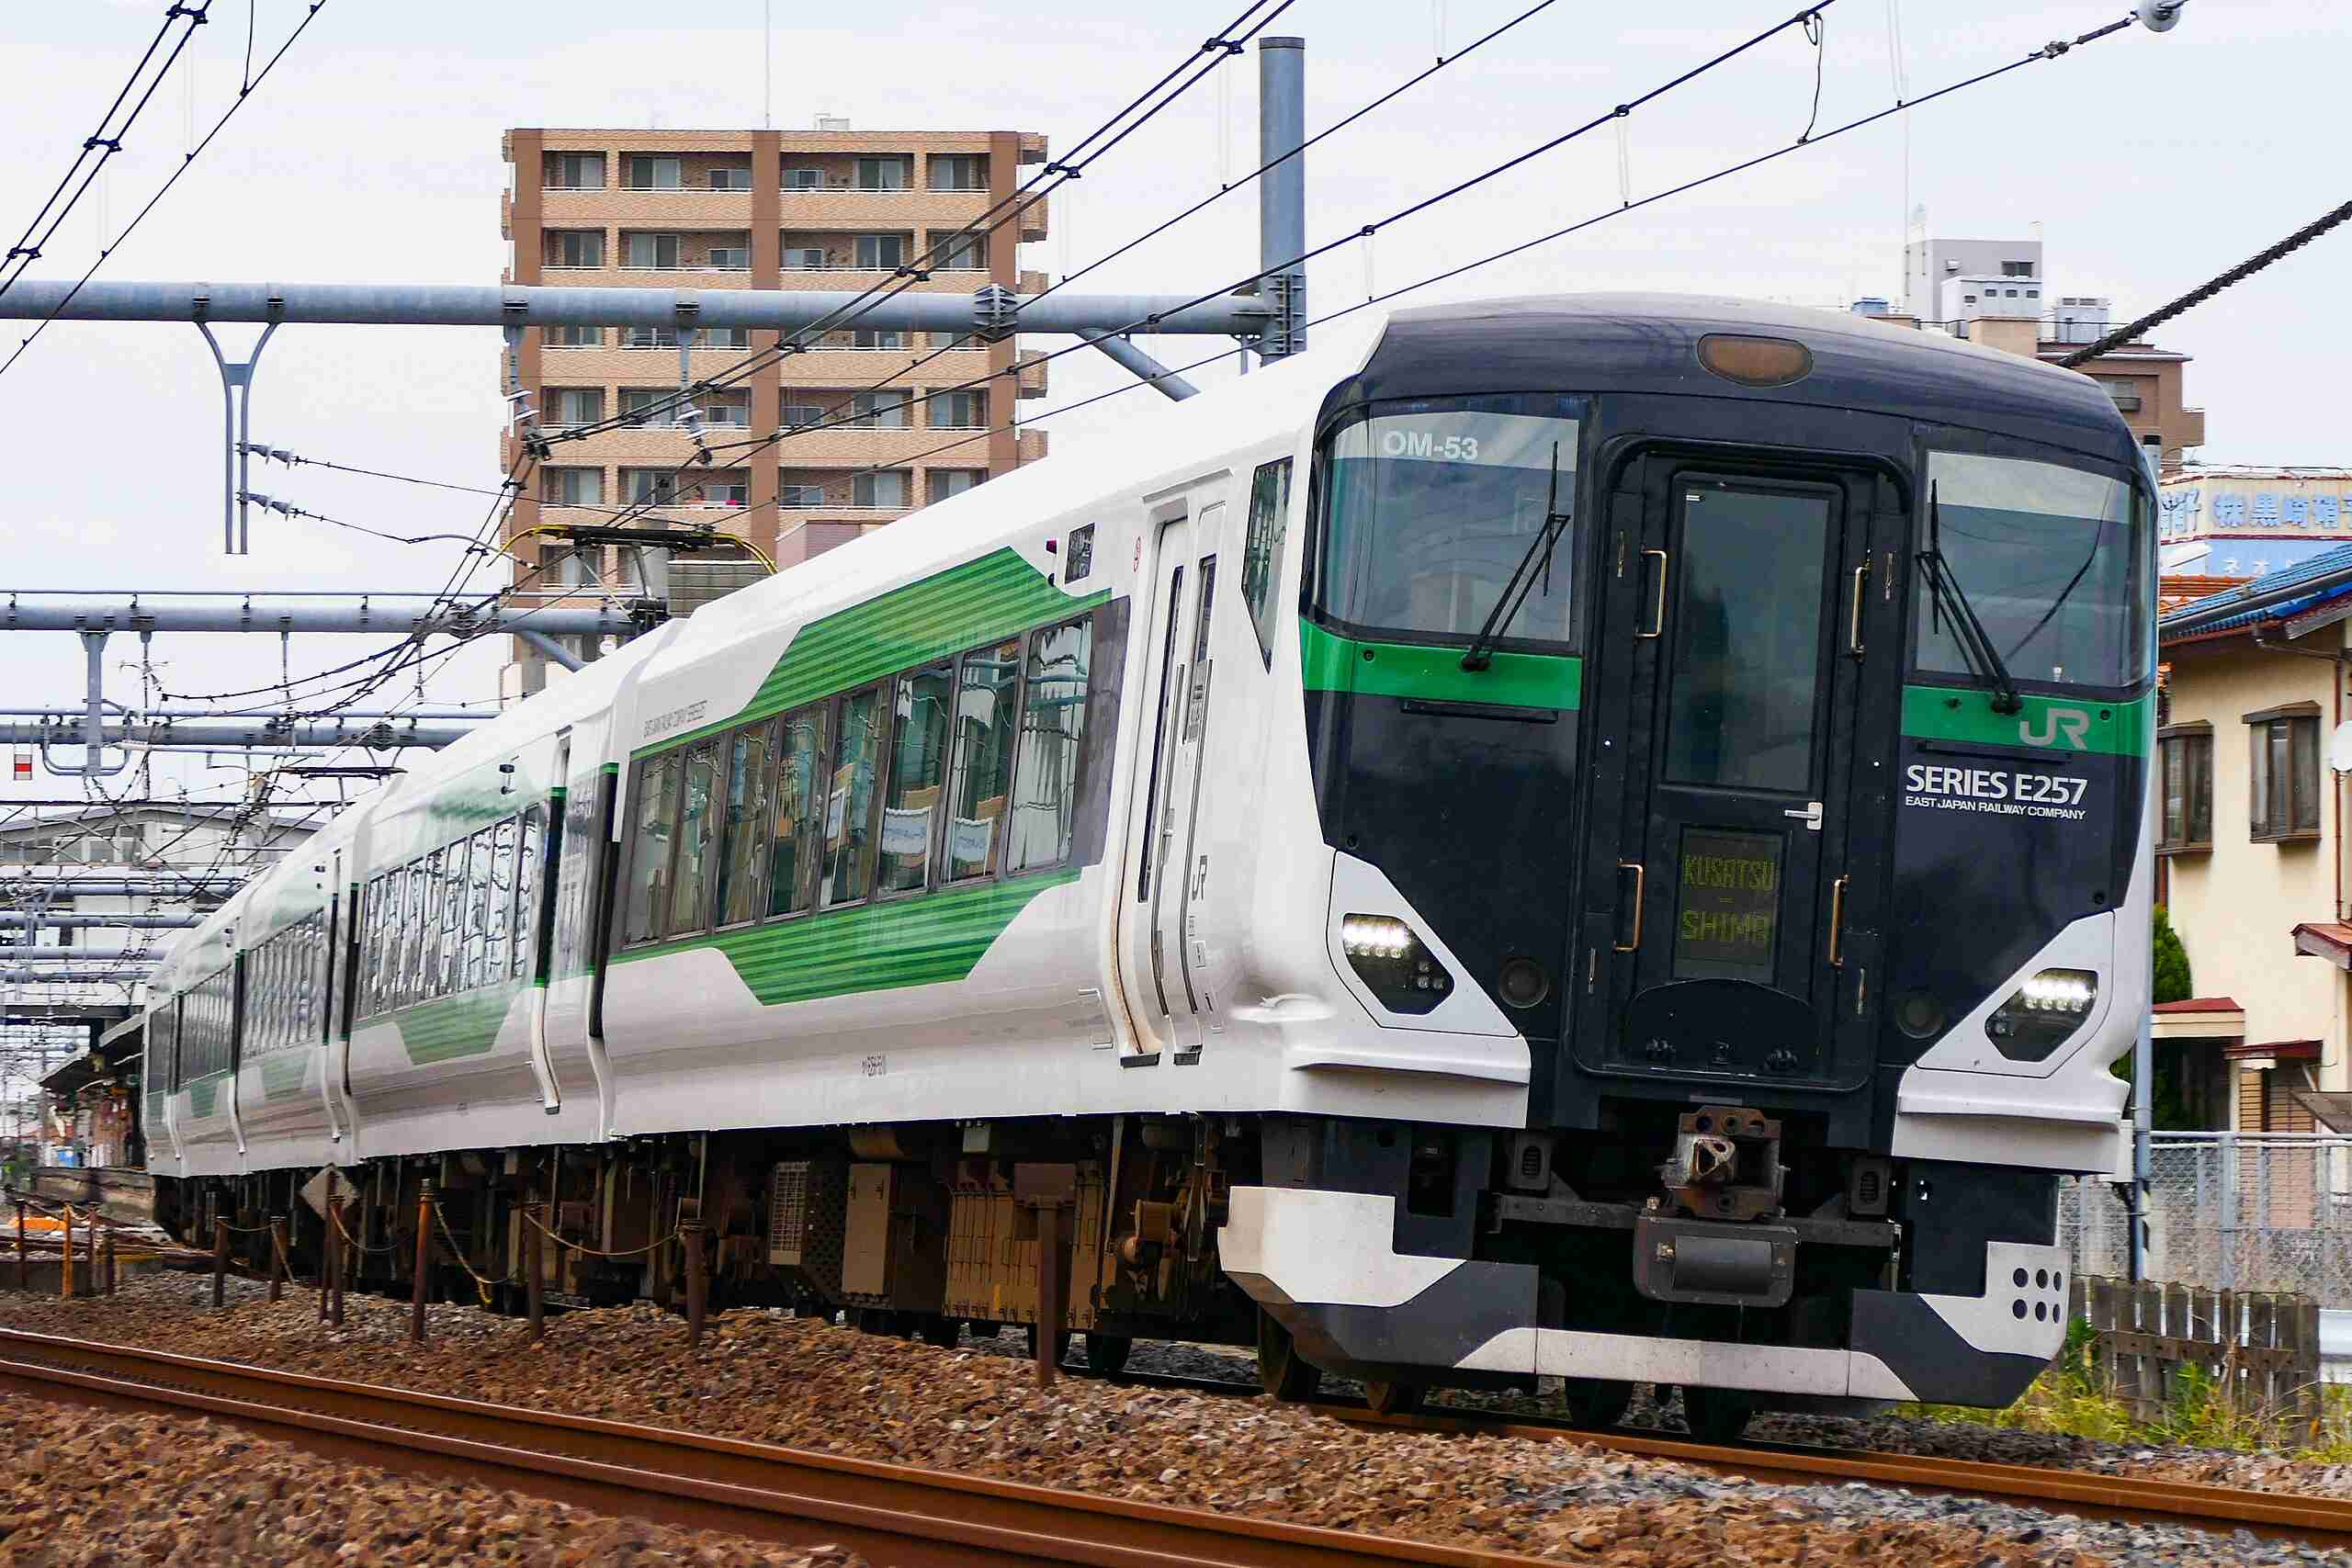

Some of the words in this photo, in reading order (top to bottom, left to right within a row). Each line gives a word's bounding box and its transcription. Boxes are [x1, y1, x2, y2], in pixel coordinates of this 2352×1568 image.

[1383, 430, 1478, 461] OM-53
[2019, 706, 2090, 750] JR
[1905, 764, 2008, 799] SERIES
[2015, 773, 2088, 806] E257
[1905, 795, 1937, 808] EAST
[1938, 798, 1976, 812] JAPAN
[1977, 801, 2027, 817] RAILWAY
[2028, 806, 2086, 821] COMPANY
[1683, 854, 1775, 890] KUSATSU
